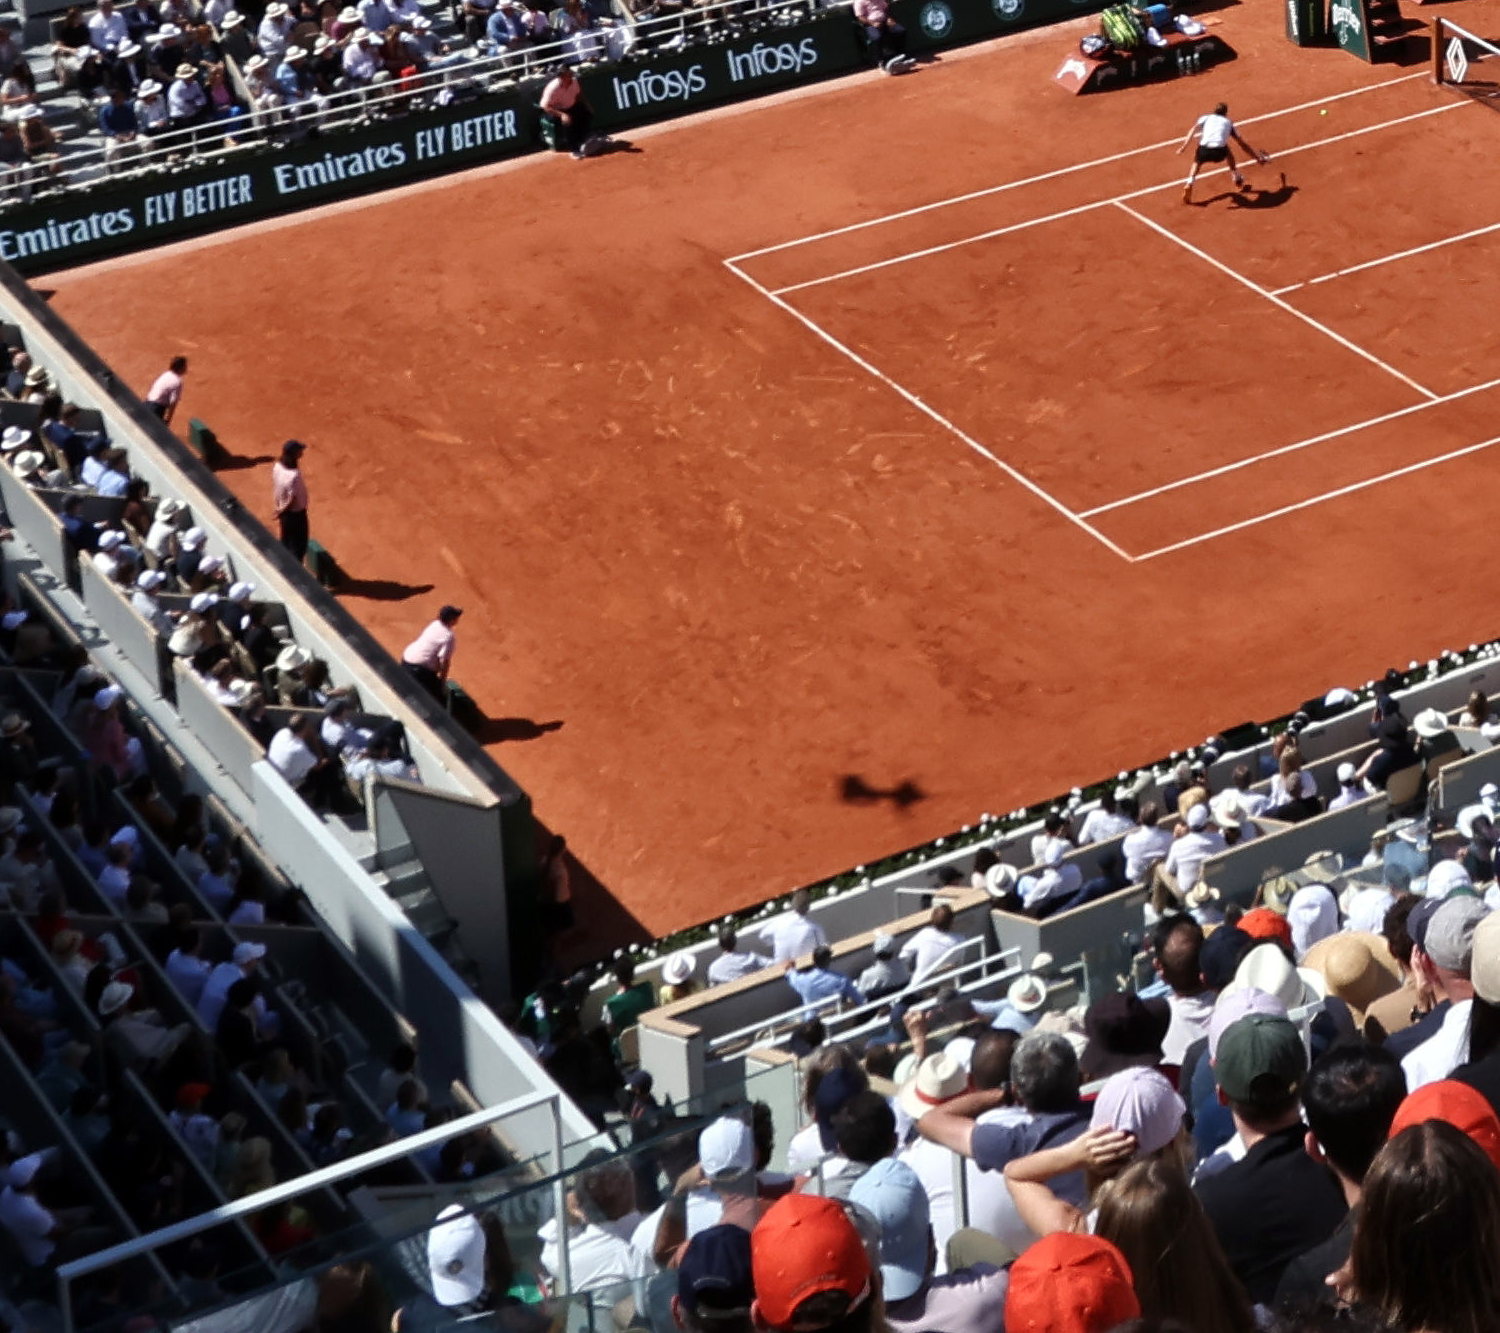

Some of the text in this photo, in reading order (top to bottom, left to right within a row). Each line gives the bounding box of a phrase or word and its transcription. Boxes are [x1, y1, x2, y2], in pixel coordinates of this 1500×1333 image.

[726, 38, 818, 83] Infosys
[612, 64, 707, 110] Infosys
[273, 109, 517, 196] Emirates FLY BETTER
[144, 189, 177, 227] FLY
[180, 174, 253, 223] BETTER
